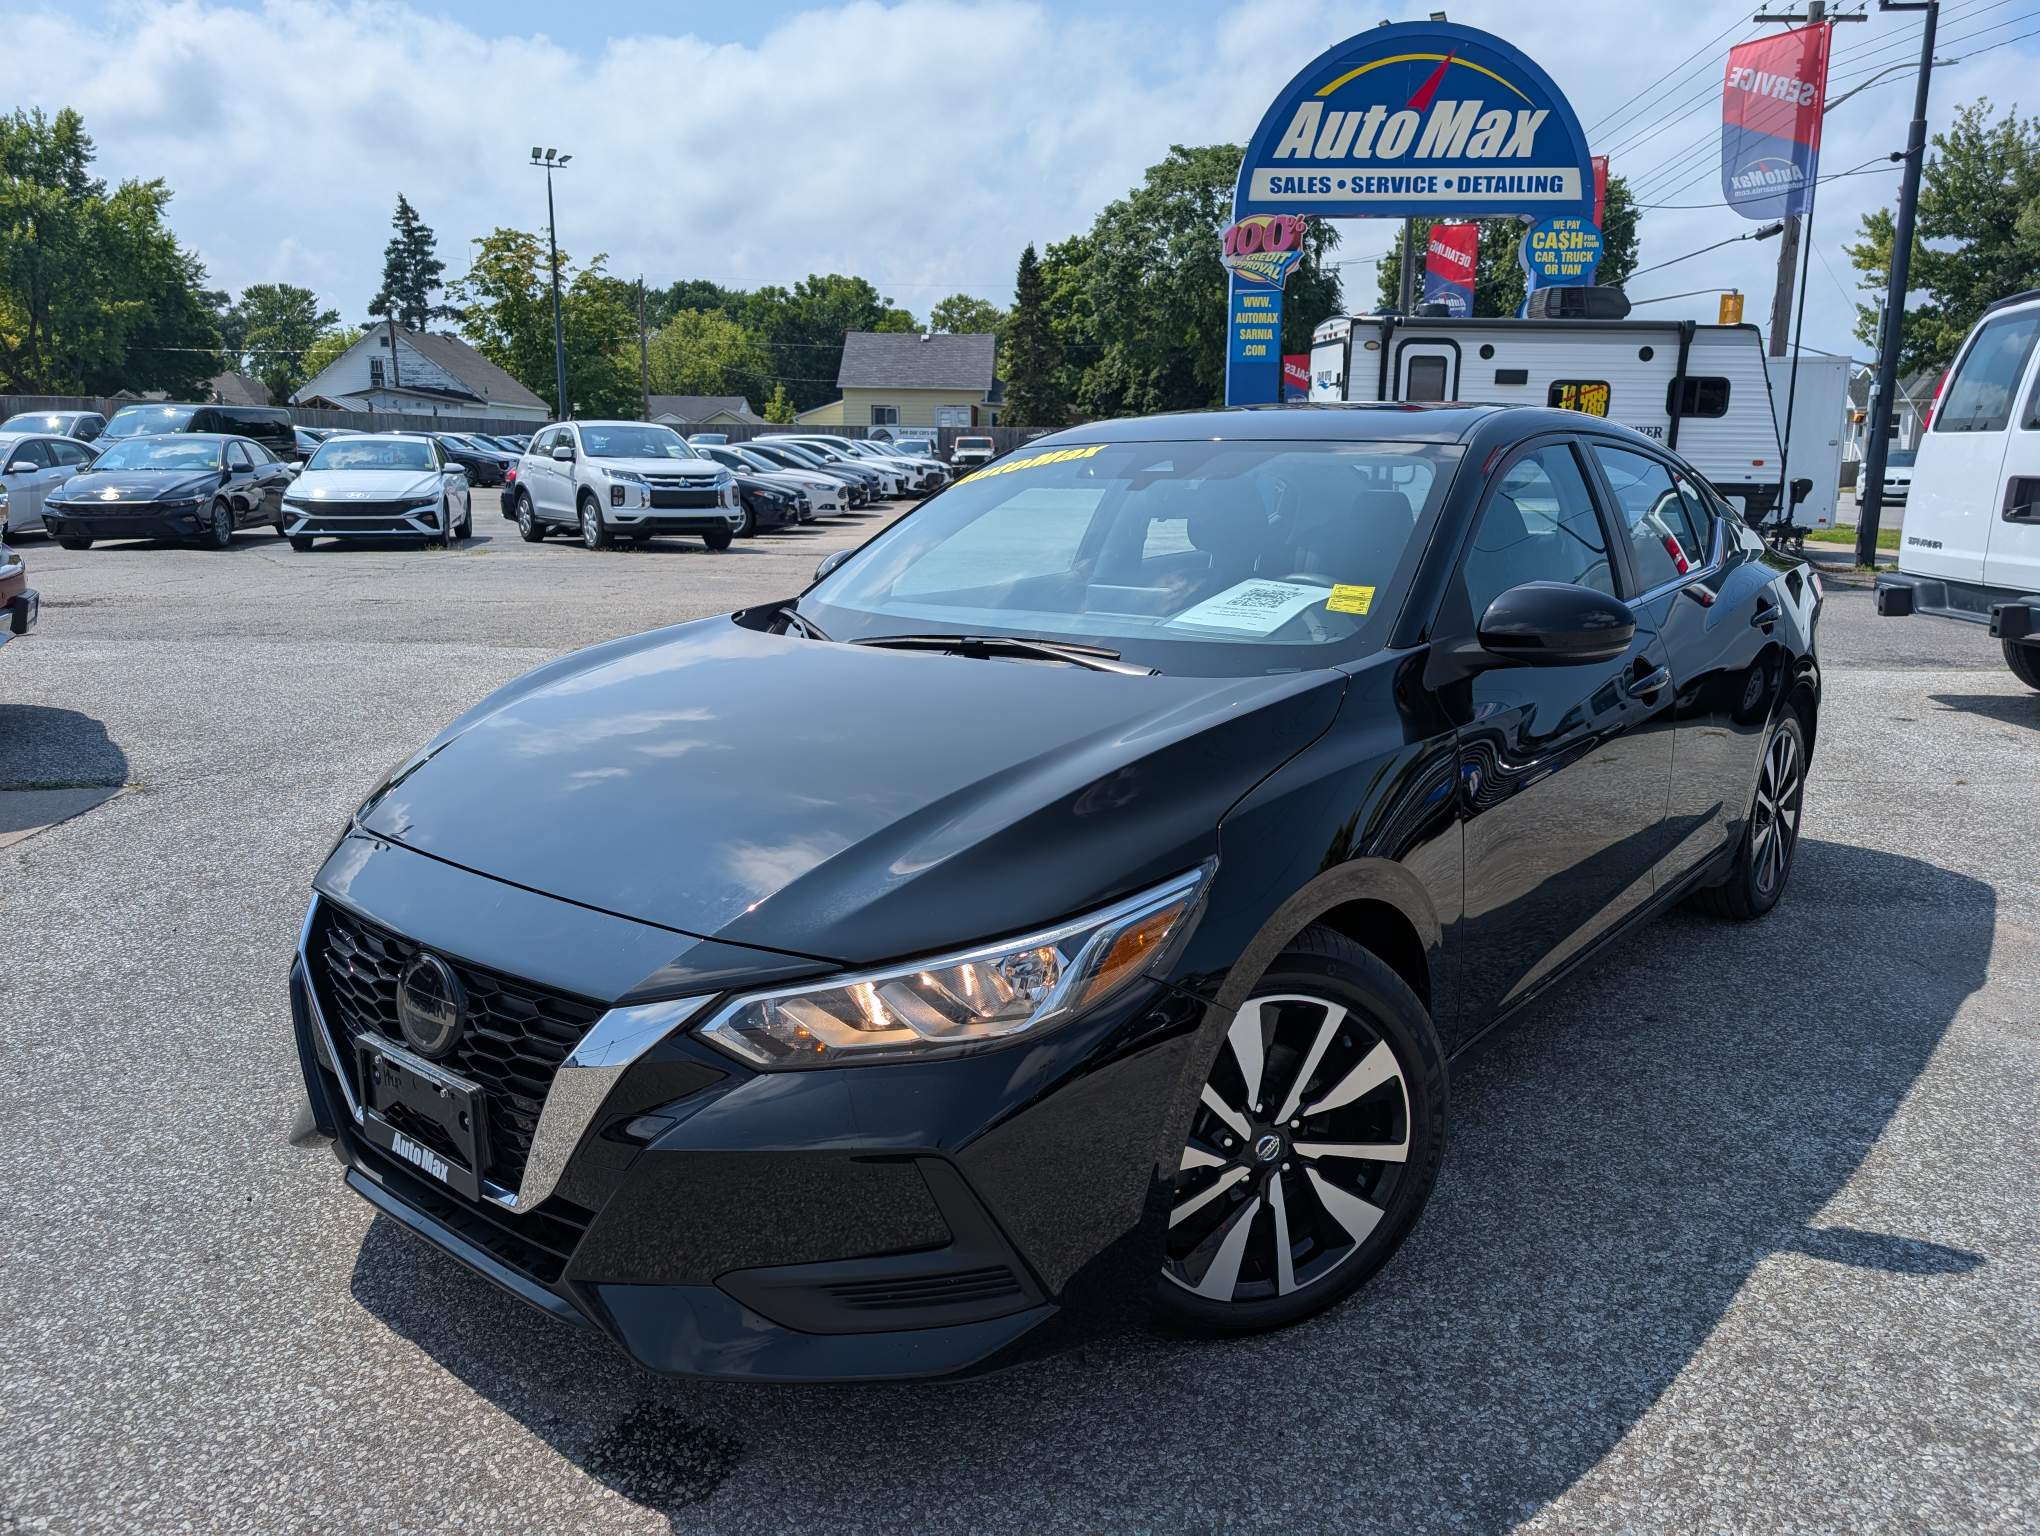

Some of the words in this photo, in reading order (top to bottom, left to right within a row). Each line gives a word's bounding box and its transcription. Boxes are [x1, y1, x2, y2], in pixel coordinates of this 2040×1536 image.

[1272, 99, 1550, 160] AutoMax
[1269, 175, 1332, 194] SALES
[1351, 175, 1438, 194] SERVICE
[1457, 175, 1563, 193] DETAILING
[1553, 220, 1565, 229] WE
[1566, 220, 1581, 229] PAY
[1224, 214, 1308, 256] 100%
[1246, 252, 1292, 265] CREDIT
[1534, 251, 1558, 263] CAR,
[1561, 251, 1594, 262] TRUCK
[1230, 260, 1281, 280] APPROVAL
[1544, 264, 1559, 275] OR
[1561, 264, 1582, 275] VAN
[1243, 296, 1272, 308] WWW.
[1235, 312, 1279, 324] AUTOMAX
[1239, 328, 1273, 340] SARNIA
[1242, 344, 1266, 356] .COM
[391, 1131, 449, 1184] AutoMax
